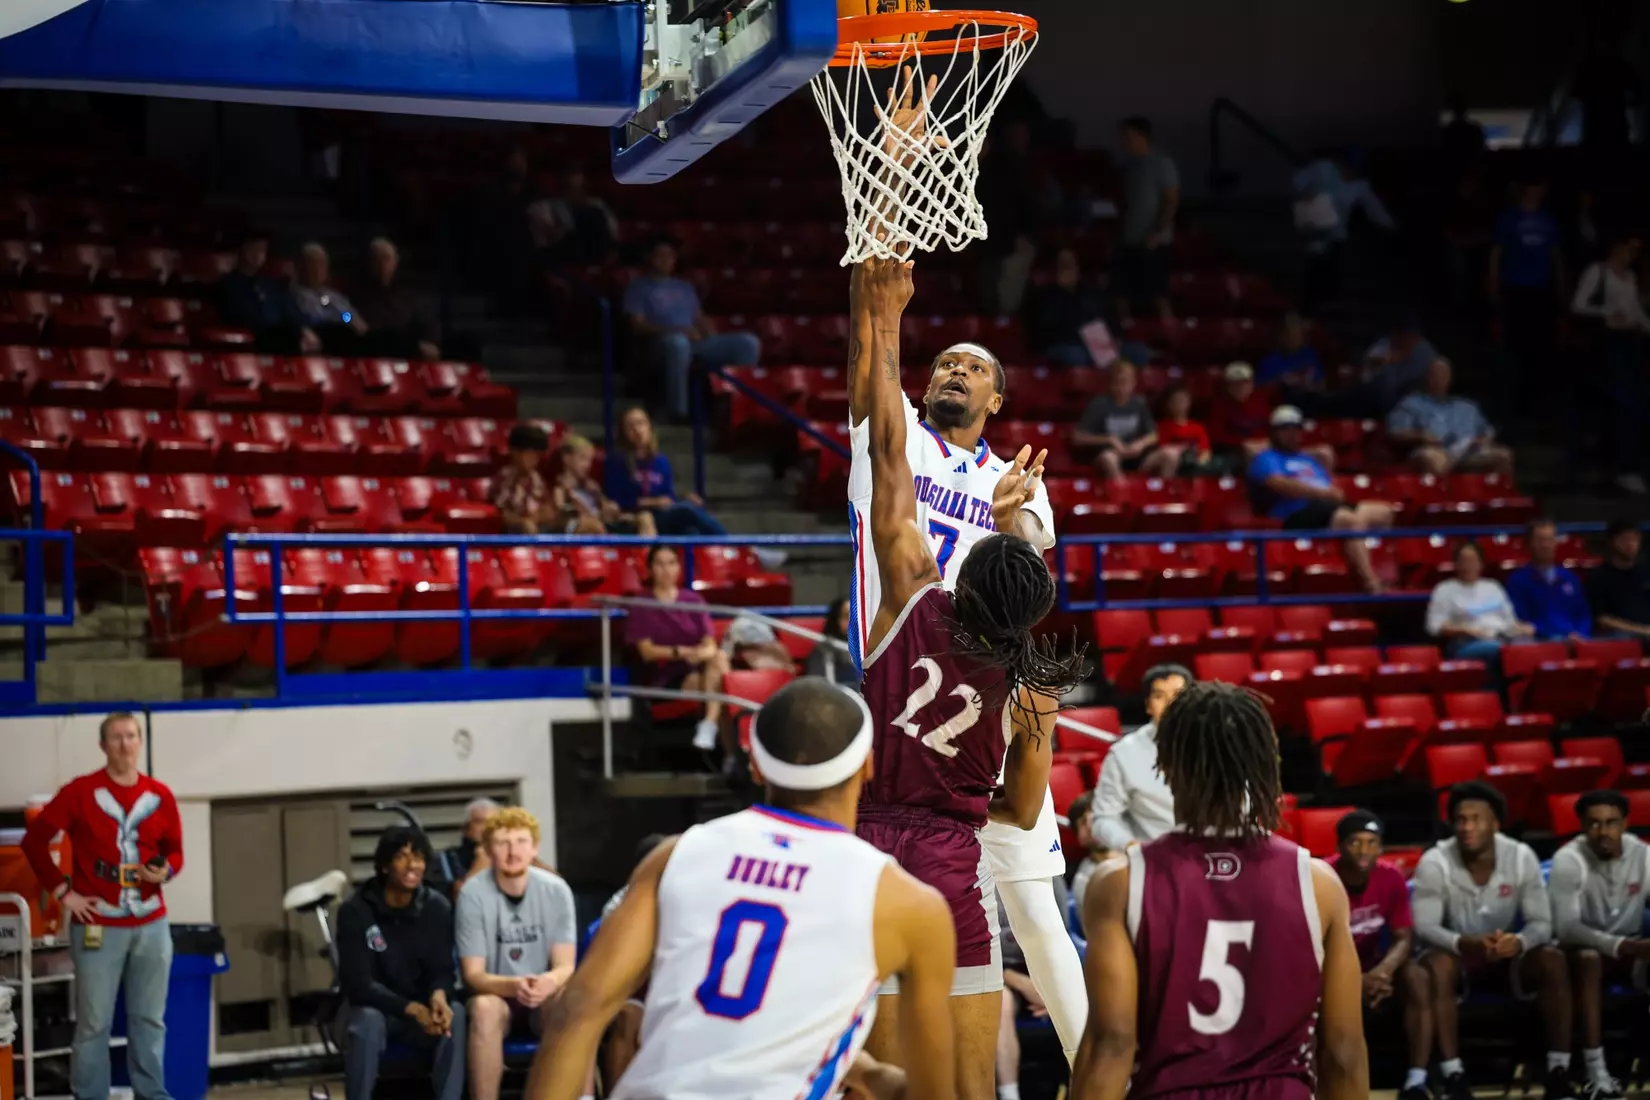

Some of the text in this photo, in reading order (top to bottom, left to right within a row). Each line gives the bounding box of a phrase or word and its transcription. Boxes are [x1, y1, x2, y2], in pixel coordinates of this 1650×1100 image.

[928, 518, 961, 581] 7
[890, 657, 983, 758] 22
[694, 898, 789, 1021] 0
[1187, 918, 1256, 1035] 5
